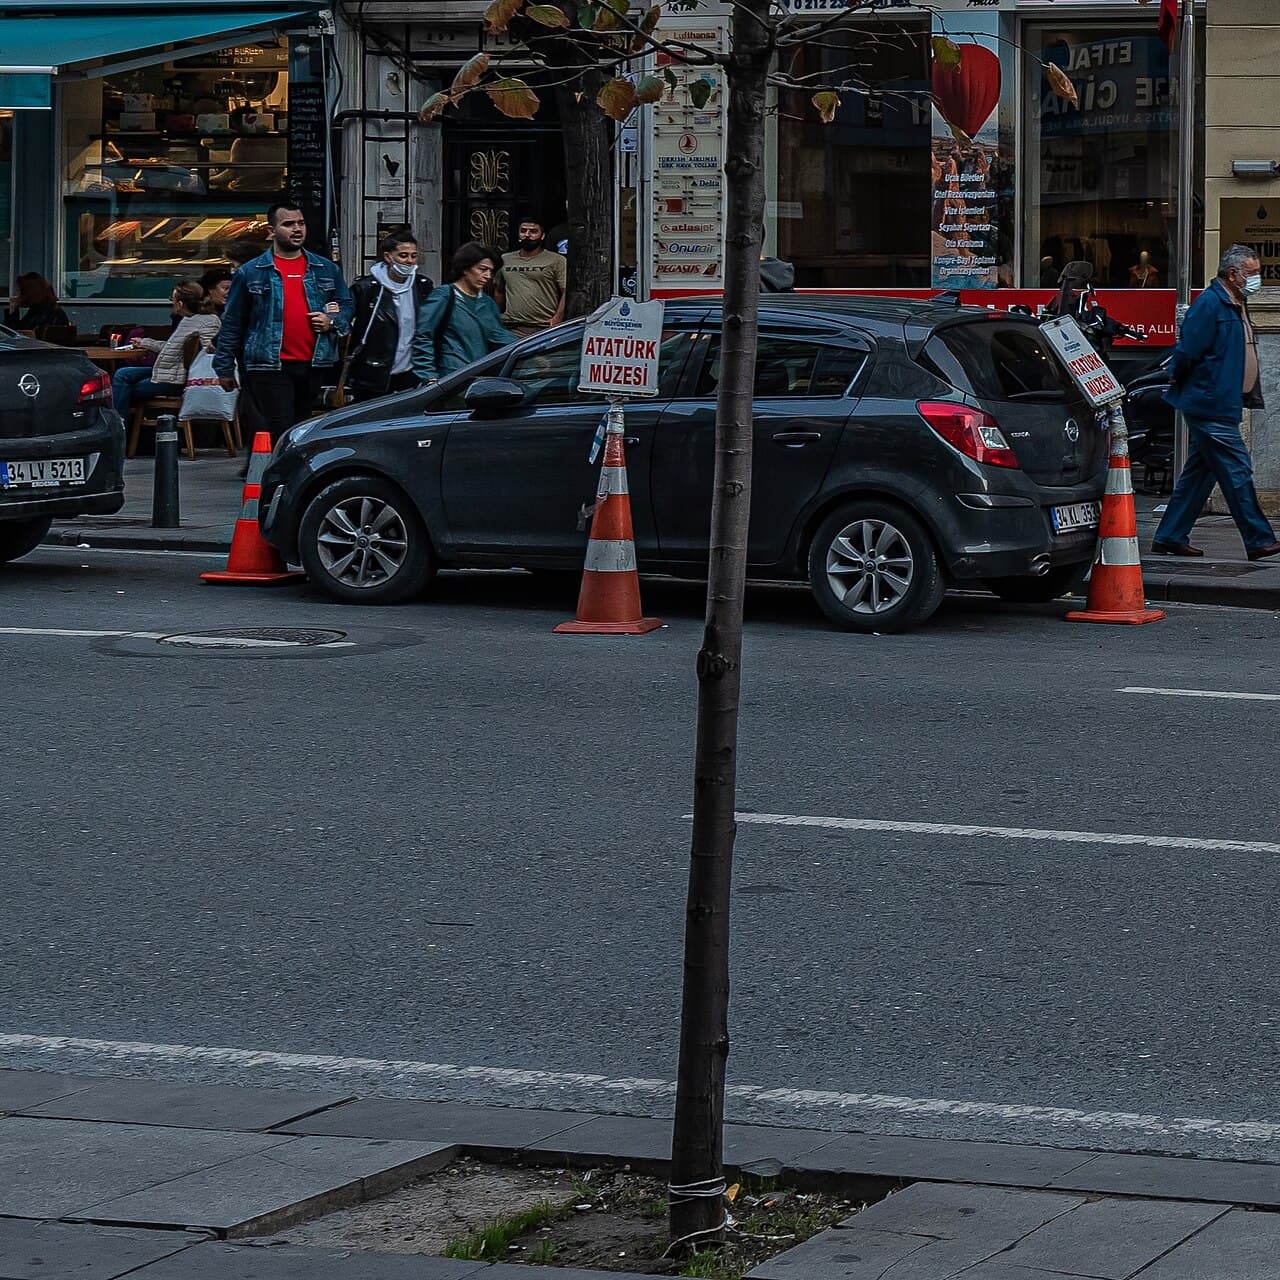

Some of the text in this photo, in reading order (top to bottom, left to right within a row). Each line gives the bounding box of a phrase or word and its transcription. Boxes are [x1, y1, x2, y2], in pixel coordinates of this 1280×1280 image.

[699, 179, 720, 188] Delta
[672, 223, 715, 234] atlasjet
[655, 263, 701, 275] PEGASUS
[585, 335, 657, 360] ATATÜRK
[589, 360, 648, 387] MÜZESİ
[1067, 352, 1104, 378] ATATÜRK
[1084, 370, 1117, 398] MÜZESİ
[8, 462, 25, 481] 34
[50, 460, 82, 479] 5213
